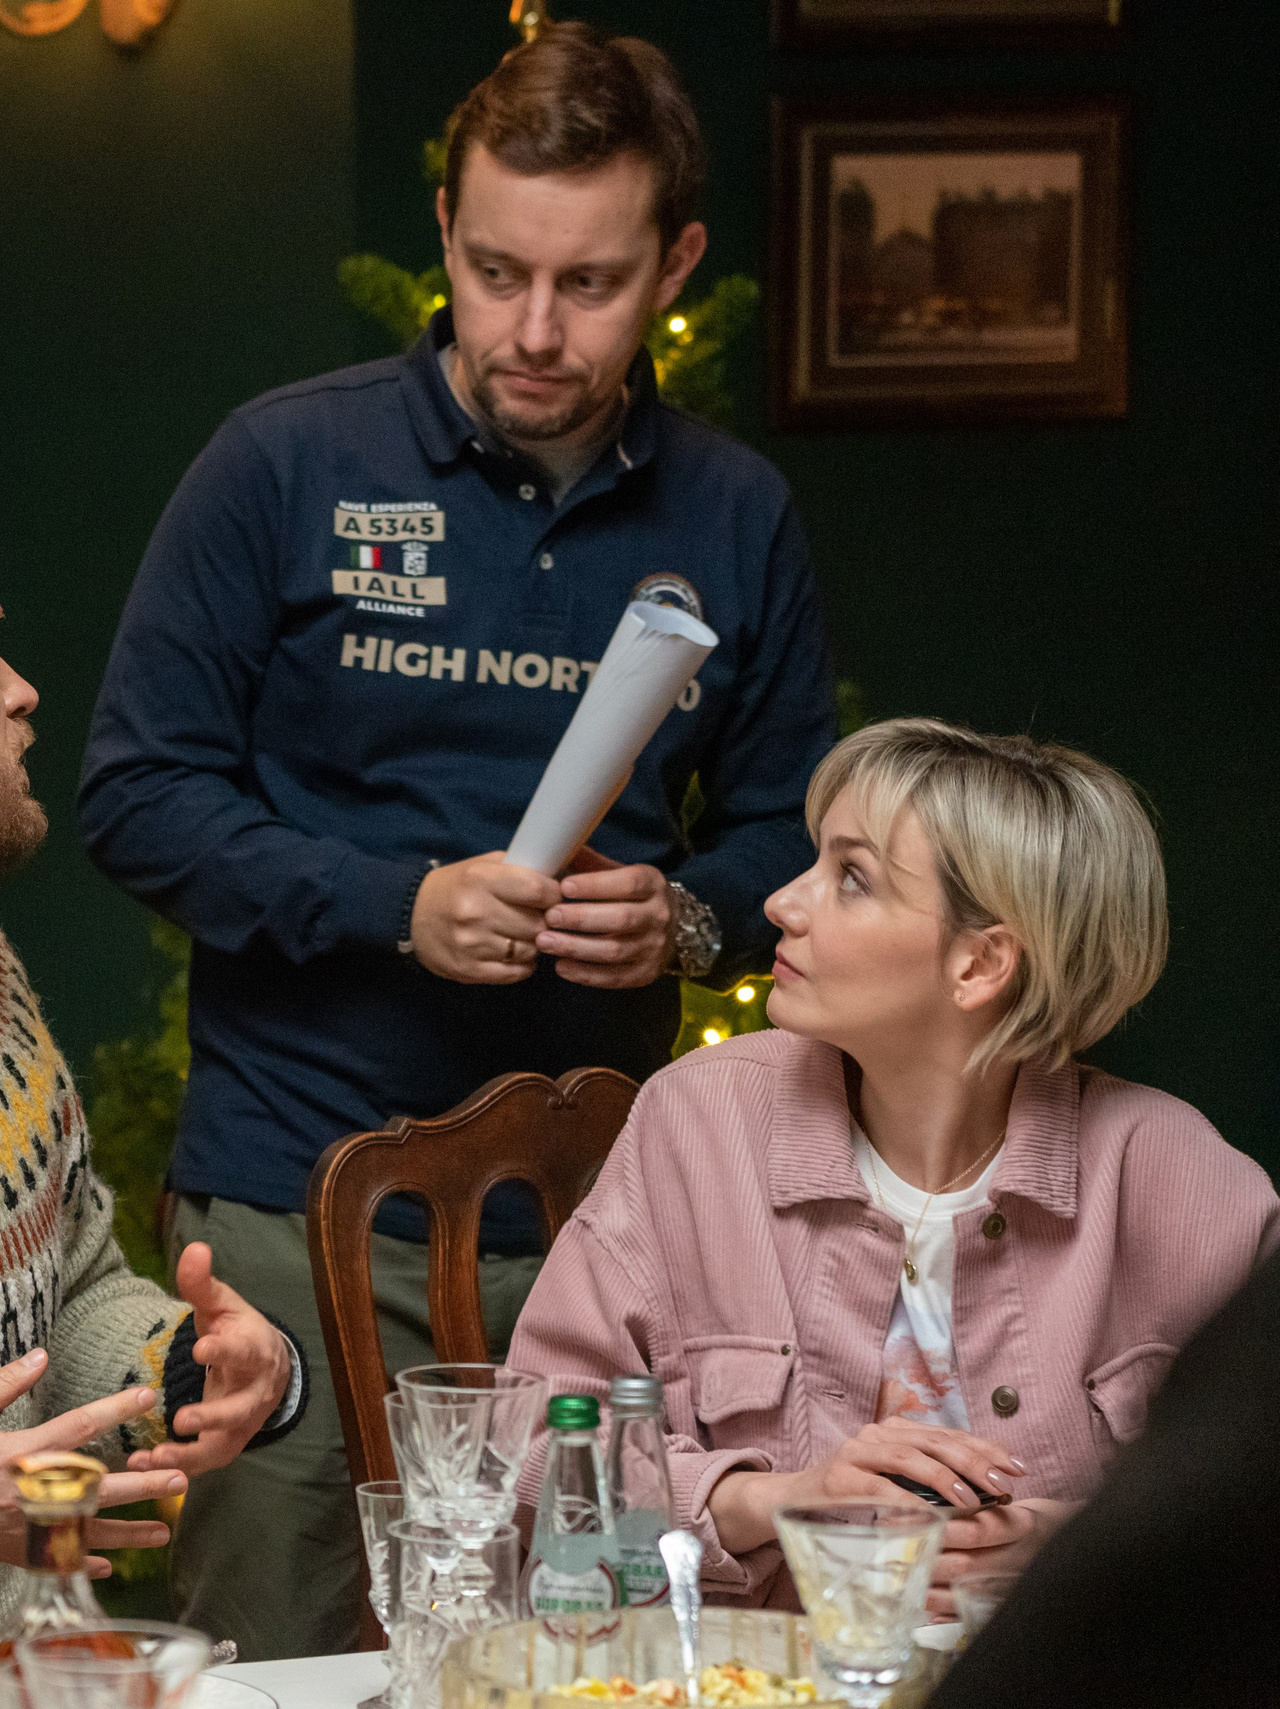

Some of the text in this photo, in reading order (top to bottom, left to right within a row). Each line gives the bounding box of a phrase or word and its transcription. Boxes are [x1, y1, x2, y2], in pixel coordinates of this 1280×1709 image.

[343, 517, 435, 536] A 5345
[352, 575, 426, 600] IALL
[355, 599, 426, 618] ALLIANCE
[340, 633, 467, 682] HIGH
[476, 649, 600, 693] NORT
